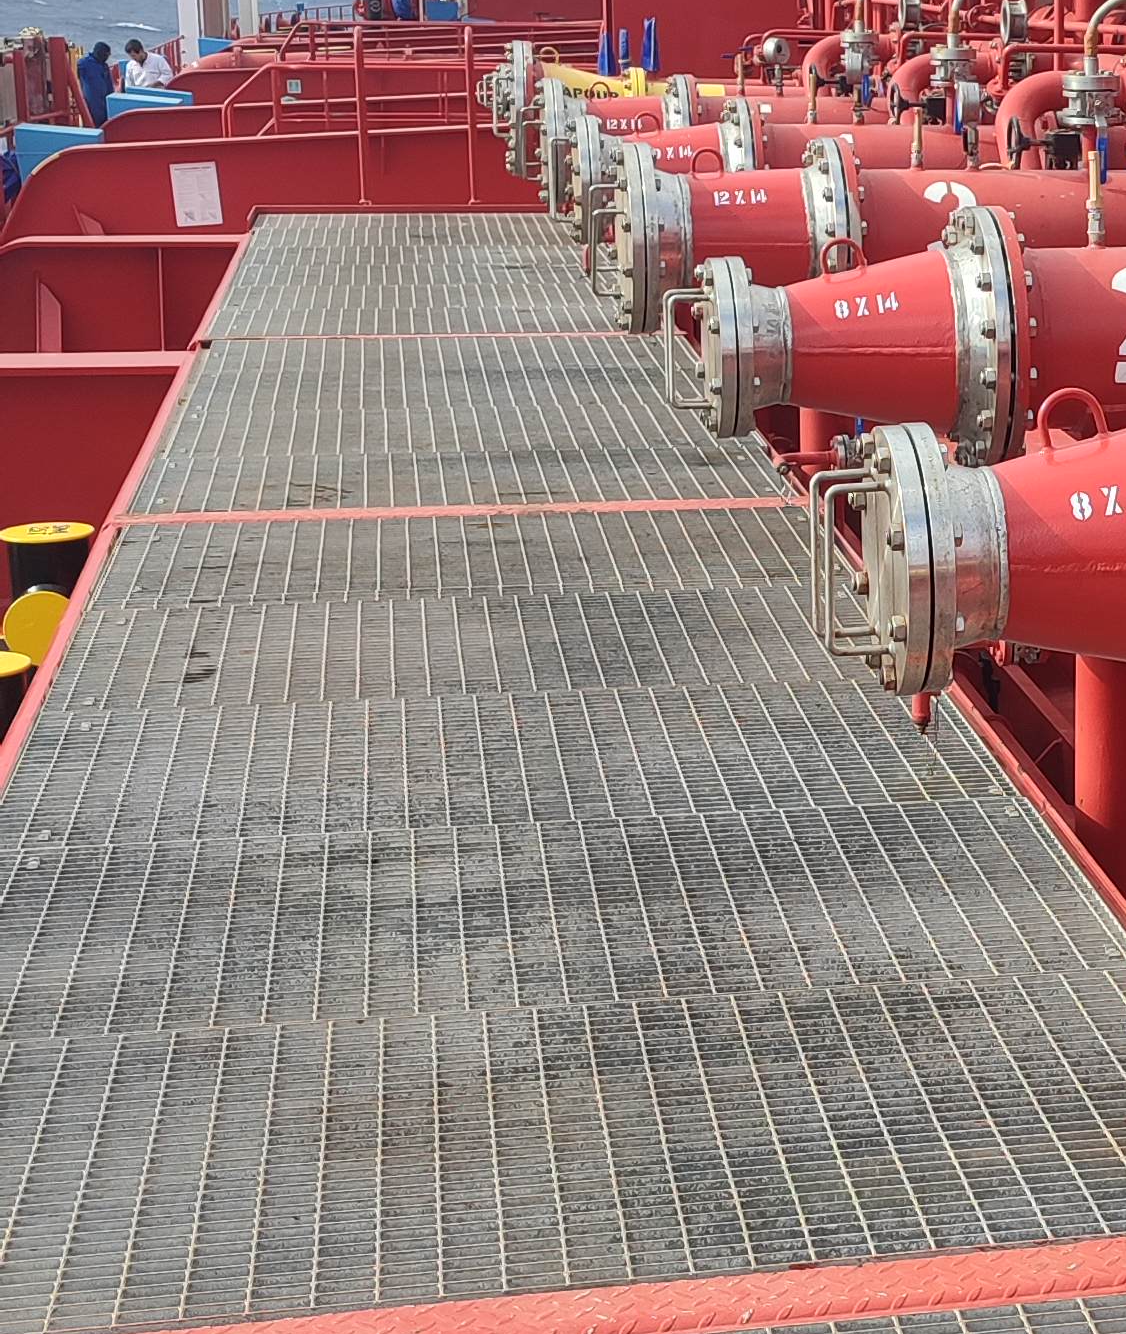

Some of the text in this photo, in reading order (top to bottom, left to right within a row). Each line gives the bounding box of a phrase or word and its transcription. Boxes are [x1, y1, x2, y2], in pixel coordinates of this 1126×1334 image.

[713, 187, 768, 206] 12 X 14
[834, 291, 899, 319] 8 X 14
[1069, 491, 1093, 522] 8
[1100, 485, 1123, 516] X
